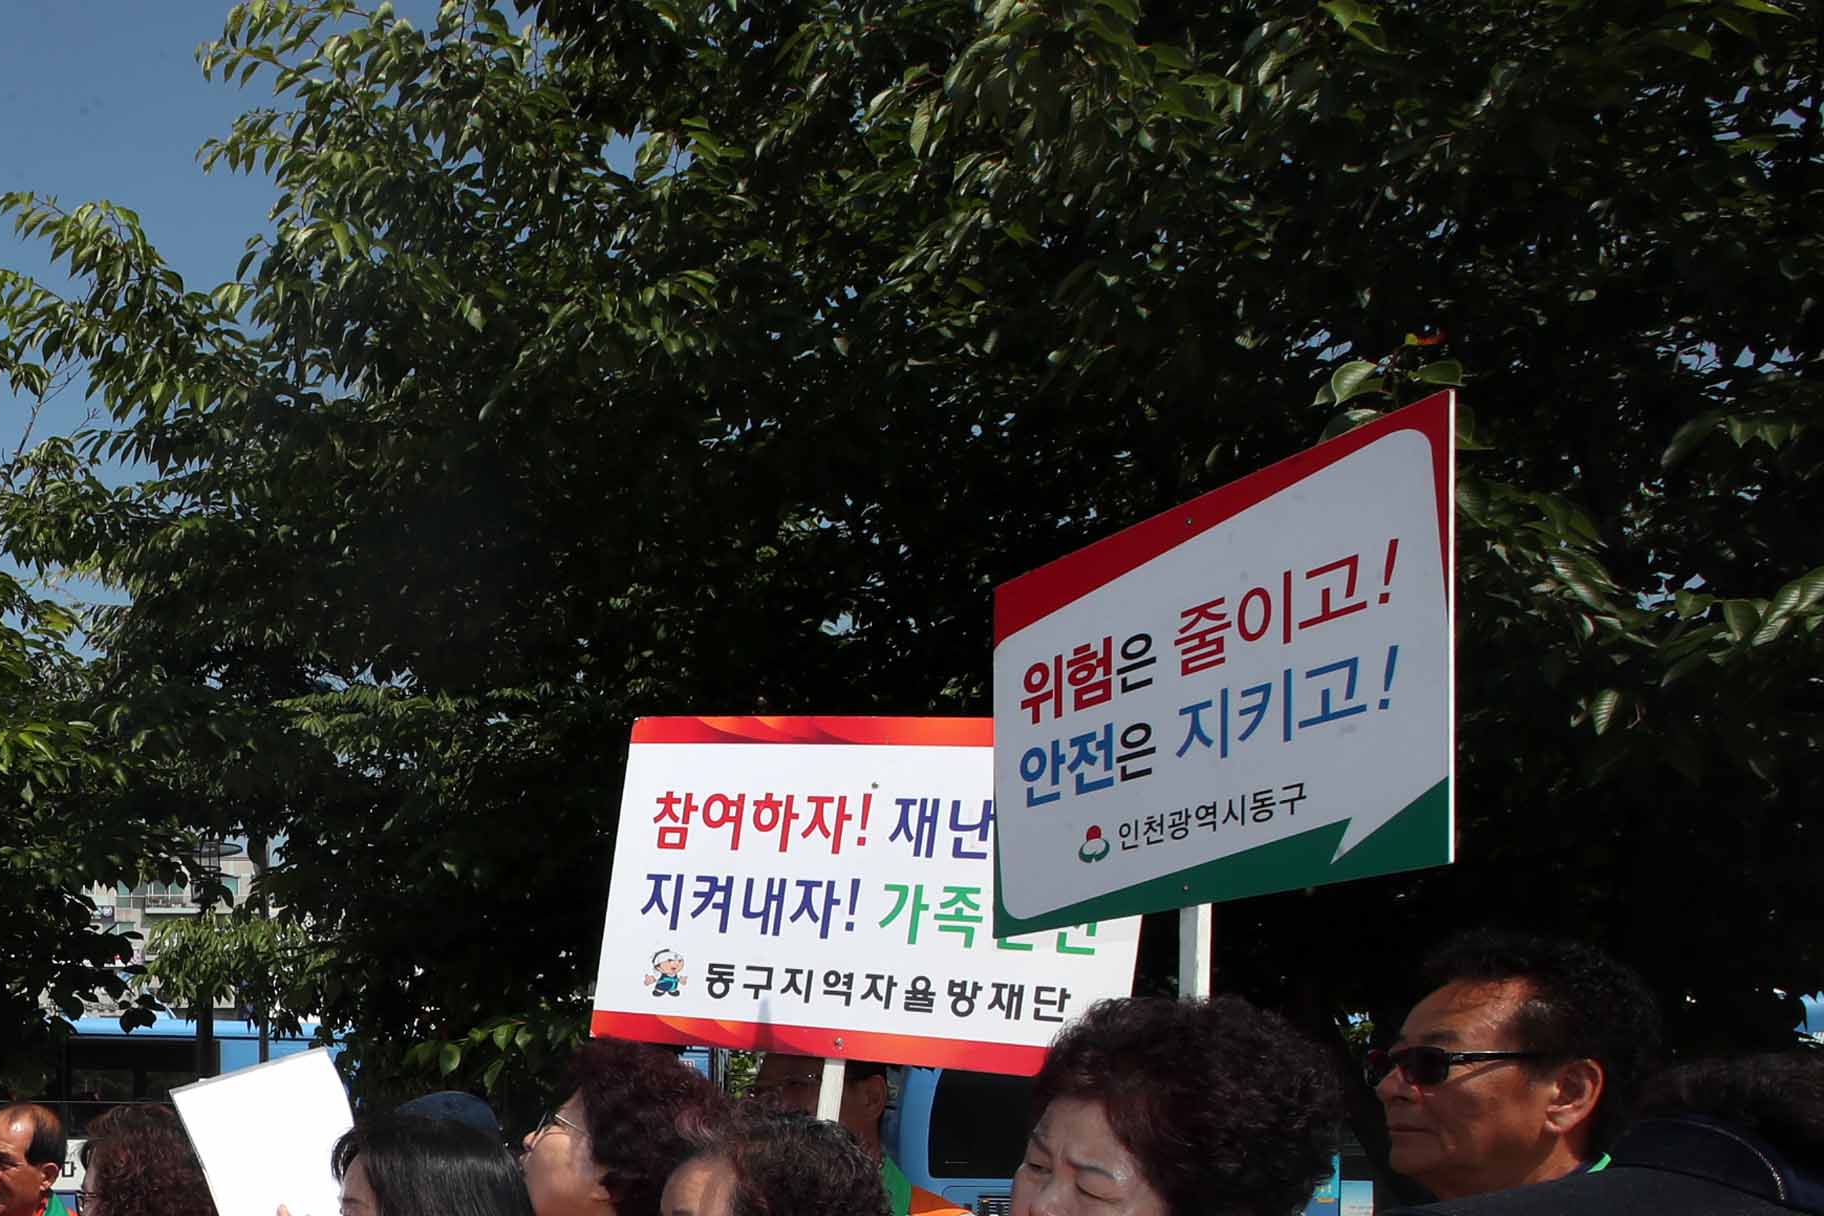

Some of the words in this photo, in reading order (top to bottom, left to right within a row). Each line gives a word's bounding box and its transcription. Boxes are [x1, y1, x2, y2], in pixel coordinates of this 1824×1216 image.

[1019, 631, 1157, 725] 위험은
[1173, 537, 1400, 678] 줄이고!
[1018, 720, 1157, 808] 안전은
[1174, 643, 1400, 760] 지키고!
[652, 790, 873, 854] 참여하자!
[888, 797, 994, 860] 재난
[1117, 781, 1308, 852] 인천광역시동구
[640, 872, 862, 940] 지켜내자!
[877, 882, 1098, 956] 가족
[704, 960, 1072, 1024] 동구지역자율방재단
